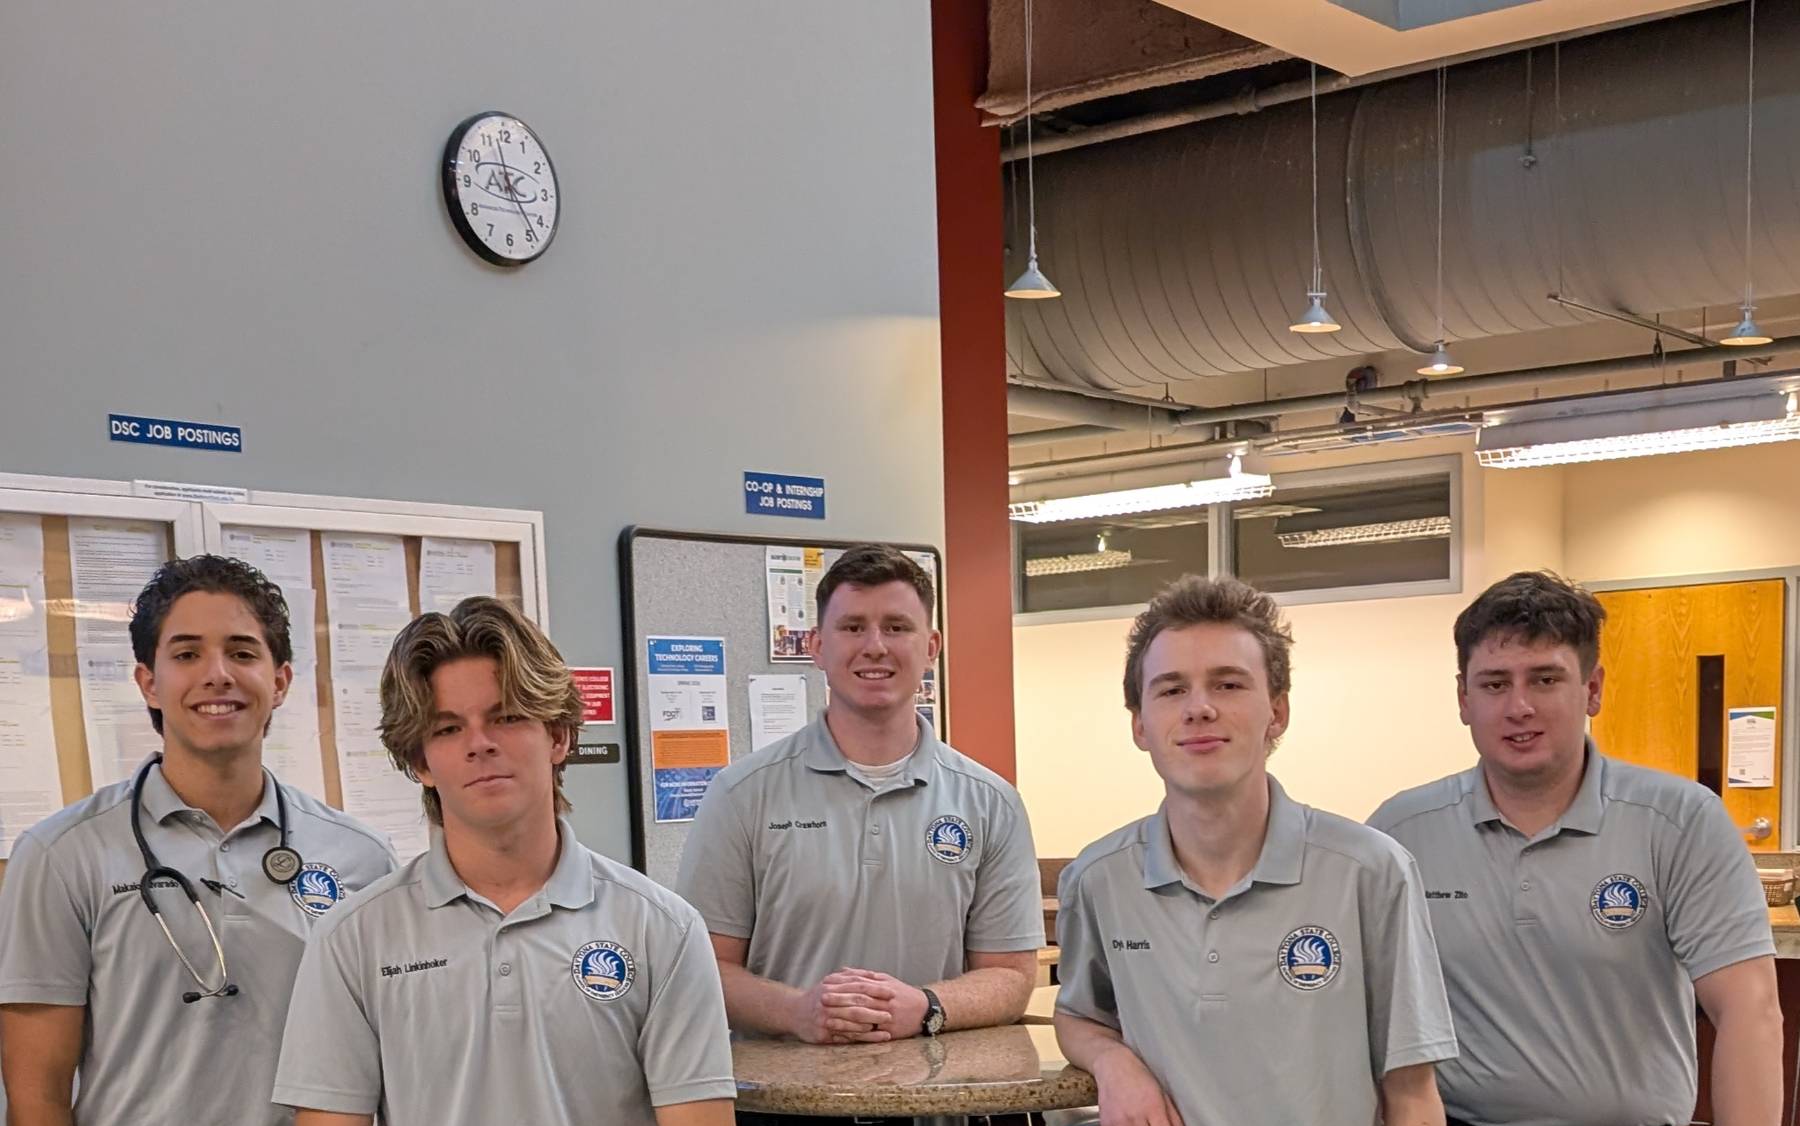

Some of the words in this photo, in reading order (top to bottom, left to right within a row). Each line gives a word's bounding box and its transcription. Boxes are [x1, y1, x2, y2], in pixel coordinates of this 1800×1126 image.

[481, 133, 493, 147] 11
[498, 129, 511, 144] 12
[520, 141, 526, 154] 1
[468, 149, 481, 163] 10
[534, 162, 541, 175] 2
[464, 175, 472, 188] 9
[485, 170, 527, 198] ATC
[541, 189, 549, 202] 3
[471, 203, 479, 216] 8
[537, 216, 545, 228] 4
[487, 224, 495, 237] 7
[526, 230, 533, 242] 5
[506, 234, 514, 247] 6
[111, 420, 140, 436] DSC
[147, 425, 172, 439] JOB
[178, 428, 239, 446] POSTINGS
[746, 481, 773, 493] CO-OP
[776, 483, 783, 494] &
[785, 485, 824, 497] INTERNSHIP
[760, 497, 774, 508] JOB
[777, 498, 812, 511] POSTINGS
[579, 747, 608, 755] DINING
[769, 821, 792, 830] Joseph
[1127, 940, 1151, 950] Harris
[1280, 933, 1298, 966] DAYTONA
[574, 944, 594, 974] DAYTONA
[595, 943, 619, 951] STATE
[381, 965, 402, 978] Elijah
